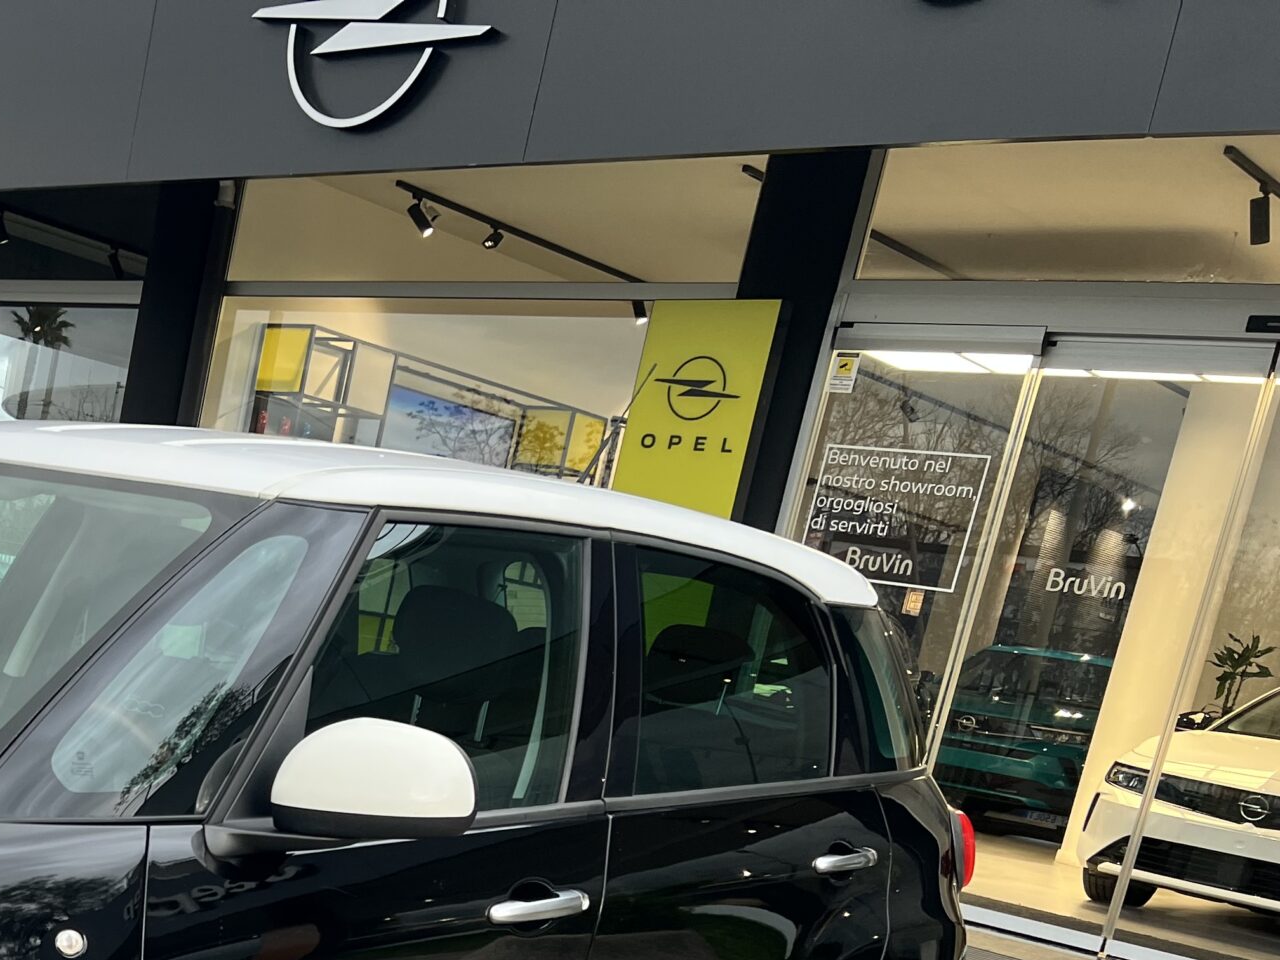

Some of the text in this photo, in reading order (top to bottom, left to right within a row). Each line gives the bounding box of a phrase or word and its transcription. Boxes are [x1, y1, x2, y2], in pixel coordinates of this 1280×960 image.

[641, 433, 732, 453] OPEL
[828, 450, 952, 473] Benvenuto nel
[821, 474, 977, 501] nostro showroom,
[816, 496, 899, 515] orgogliosi
[810, 515, 890, 537] di servirti
[845, 546, 913, 576] BruVin
[1045, 567, 1126, 600] BruVin
